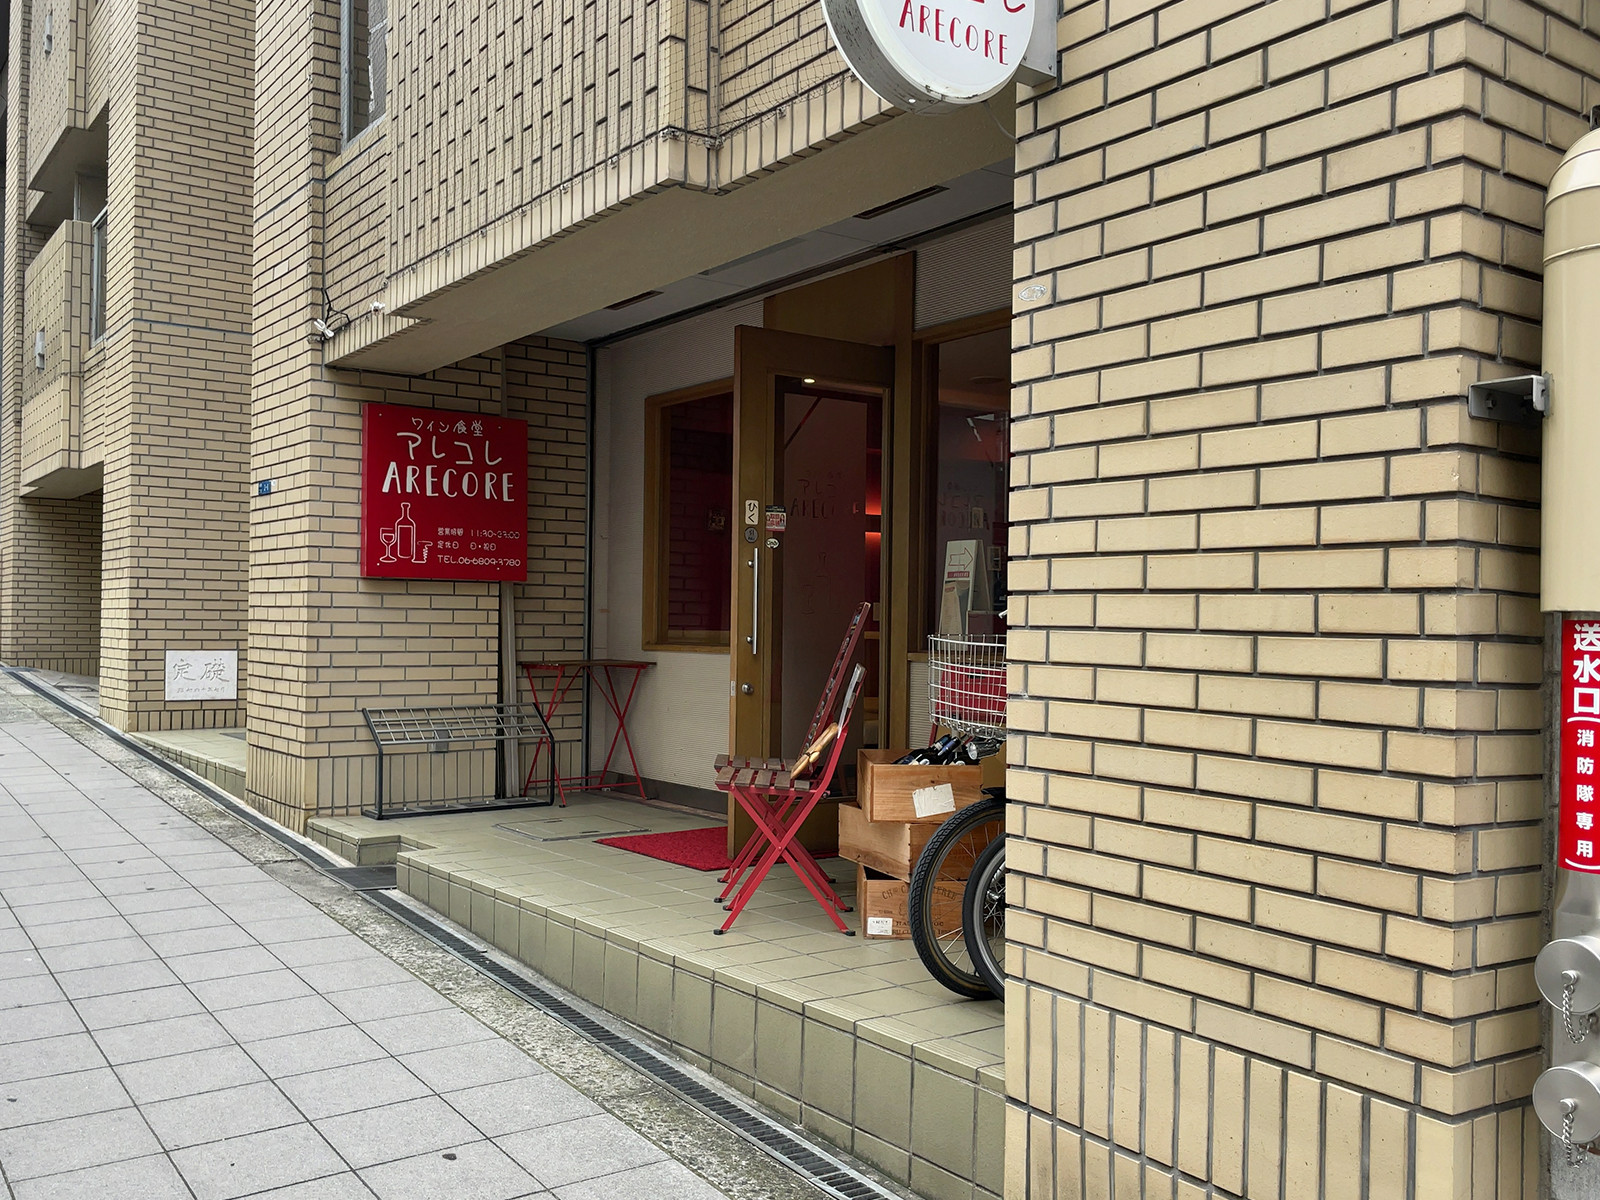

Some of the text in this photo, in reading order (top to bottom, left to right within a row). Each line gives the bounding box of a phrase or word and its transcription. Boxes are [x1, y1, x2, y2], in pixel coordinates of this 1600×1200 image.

[899, 0, 1009, 66] ARECORE
[411, 417, 484, 437] ワイン食堂
[396, 431, 503, 466] アレコレ
[382, 461, 515, 502] ARECORE
[747, 502, 758, 523] ひく
[172, 658, 230, 683] 定礎
[1573, 623, 1600, 715] 送水口
